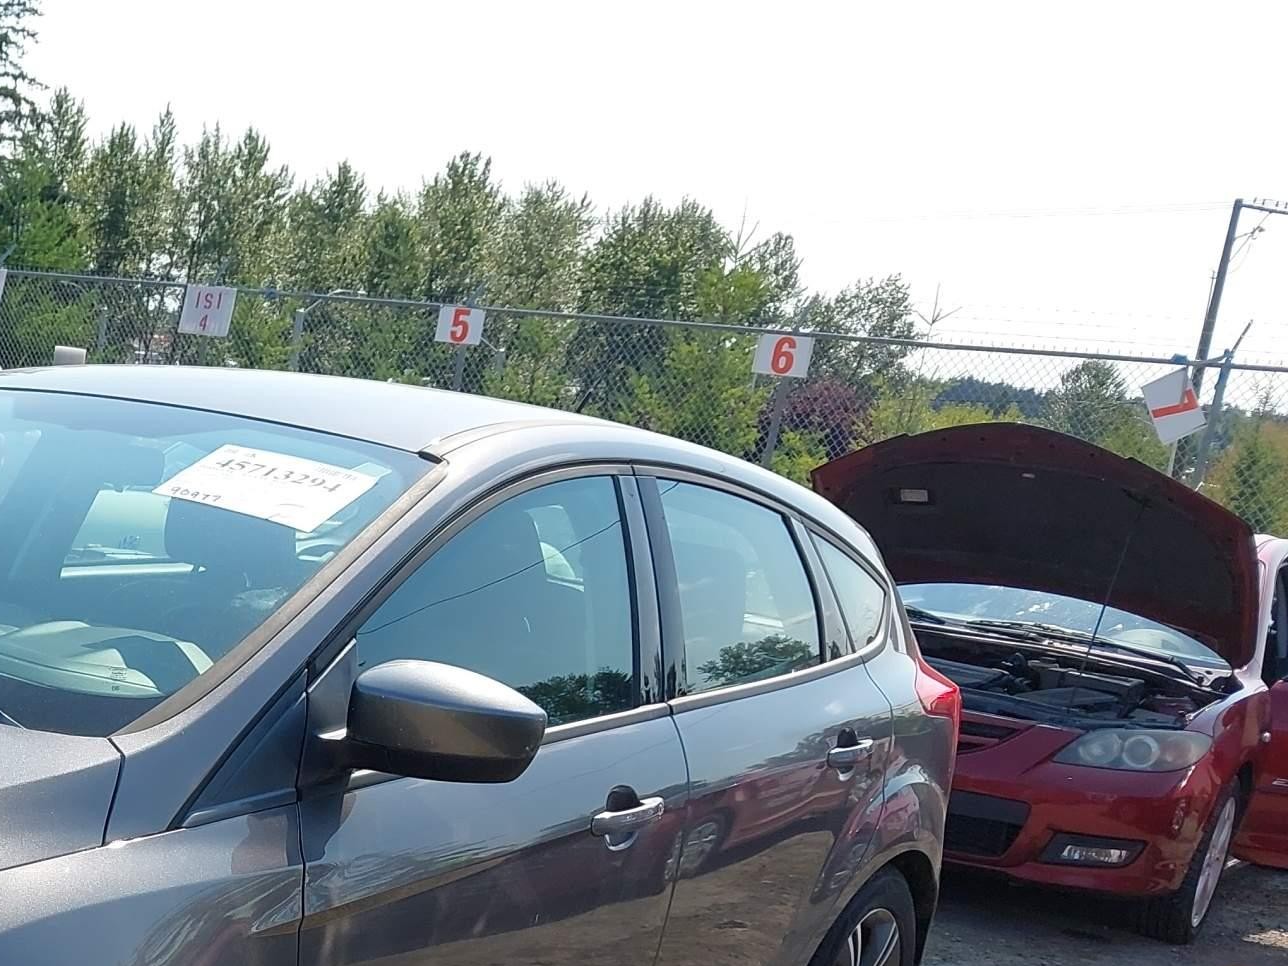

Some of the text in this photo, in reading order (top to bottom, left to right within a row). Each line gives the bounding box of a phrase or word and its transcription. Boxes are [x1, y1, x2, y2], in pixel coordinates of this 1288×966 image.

[198, 312, 209, 332] 4
[449, 307, 472, 343] 5
[770, 335, 797, 375] 6
[215, 457, 343, 494] 45713294
